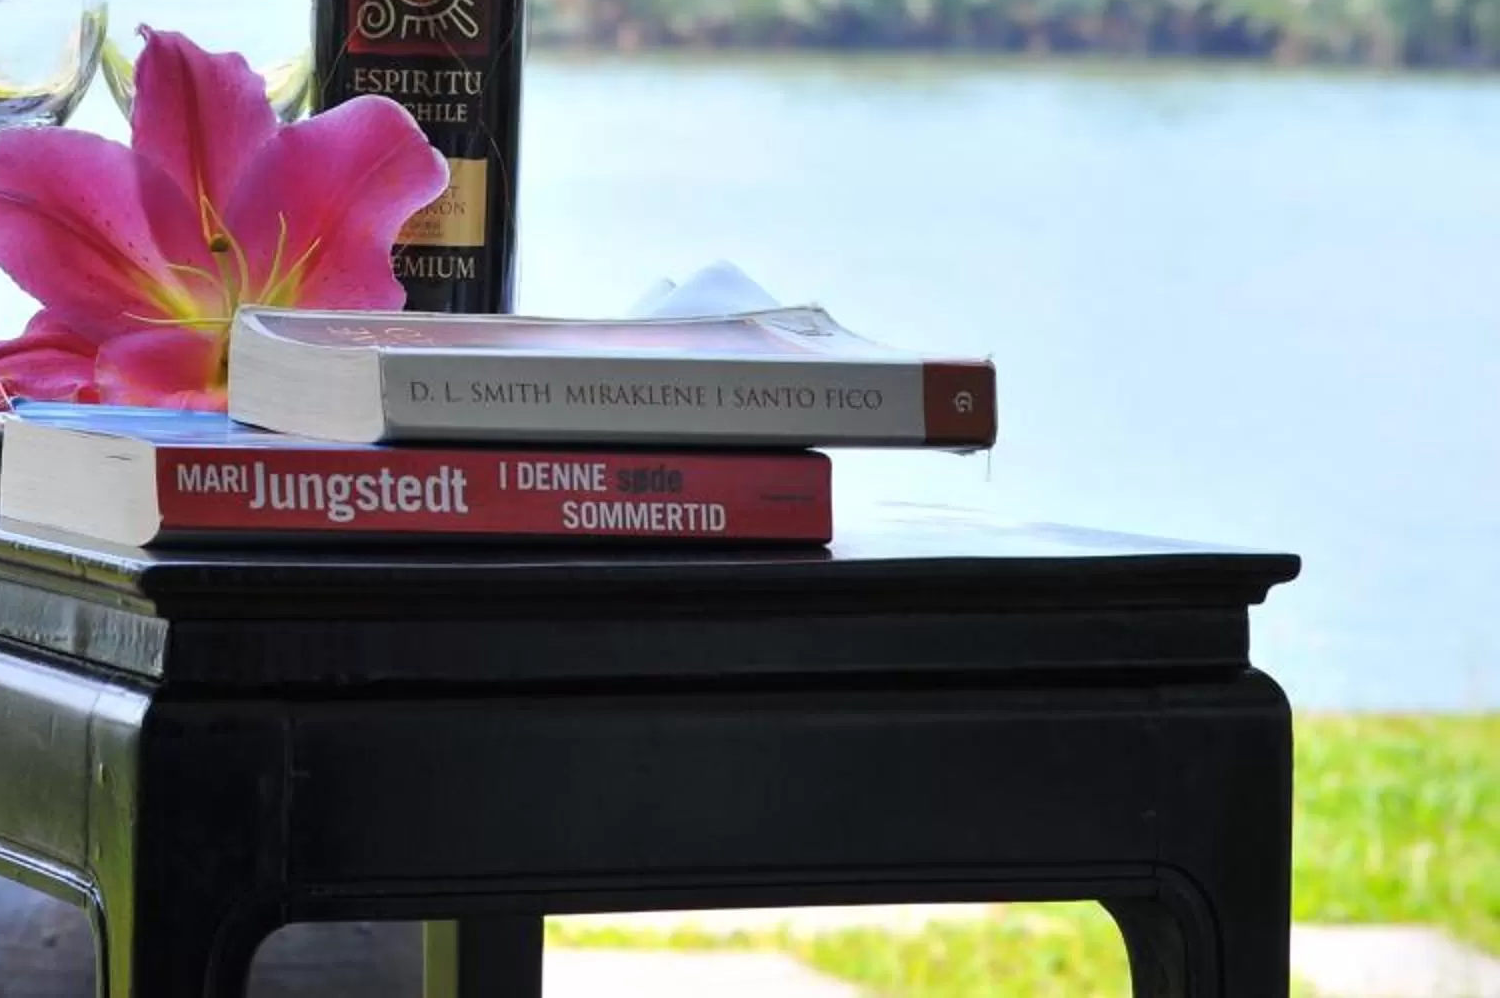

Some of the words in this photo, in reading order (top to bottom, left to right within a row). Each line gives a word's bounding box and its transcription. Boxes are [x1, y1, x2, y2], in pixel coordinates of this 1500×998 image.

[353, 67, 483, 98] ESPIRITU
[392, 254, 476, 279] EMIUM
[470, 381, 551, 405] SMITH
[565, 383, 706, 408] MIRAKLENE
[733, 385, 816, 410] SANTO
[824, 388, 884, 411] FICO
[177, 463, 248, 494] MARI
[249, 461, 469, 523] Jungstedt
[499, 461, 508, 491] I
[517, 462, 607, 492] DENNE
[562, 500, 727, 532] SOMMERTID
